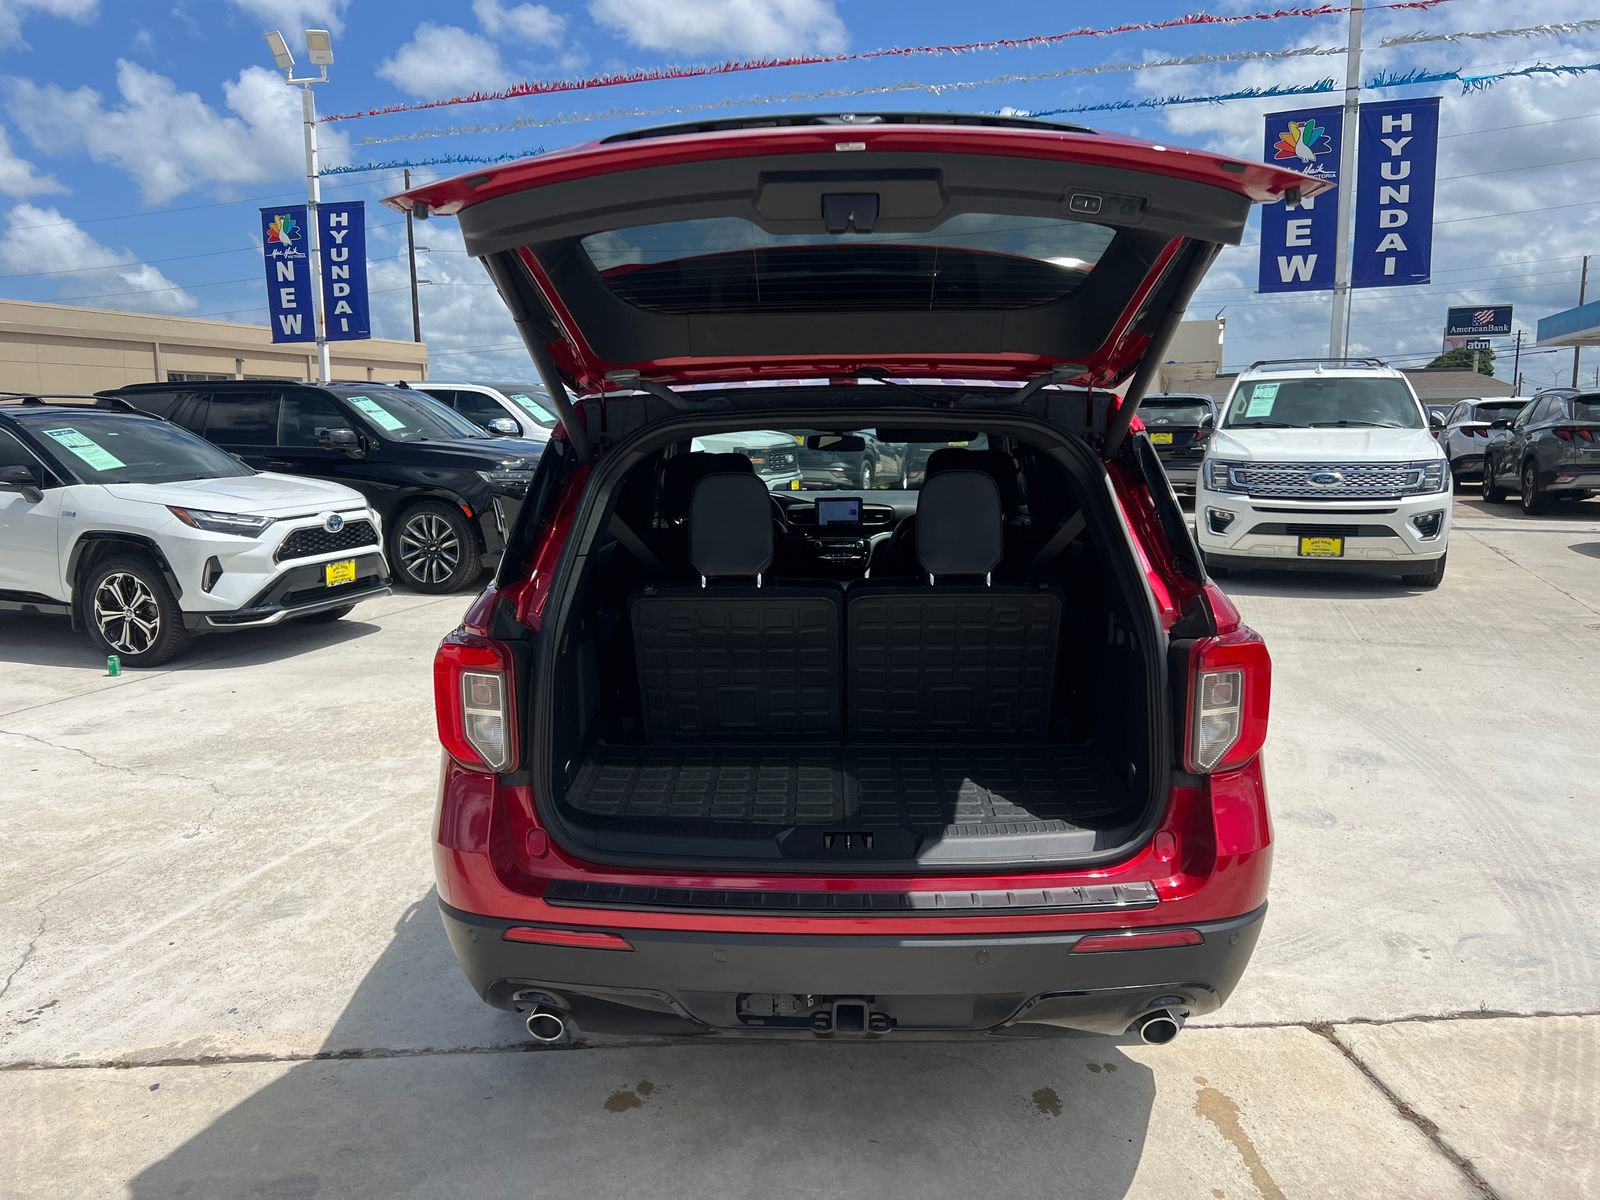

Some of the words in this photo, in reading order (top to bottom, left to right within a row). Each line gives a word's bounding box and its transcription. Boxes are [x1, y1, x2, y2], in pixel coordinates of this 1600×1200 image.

[1375, 113, 1414, 276] HYUNDAI
[276, 261, 302, 335] NEW
[329, 212, 353, 332] HYUNDAI
[1467, 341, 1489, 350] atm
